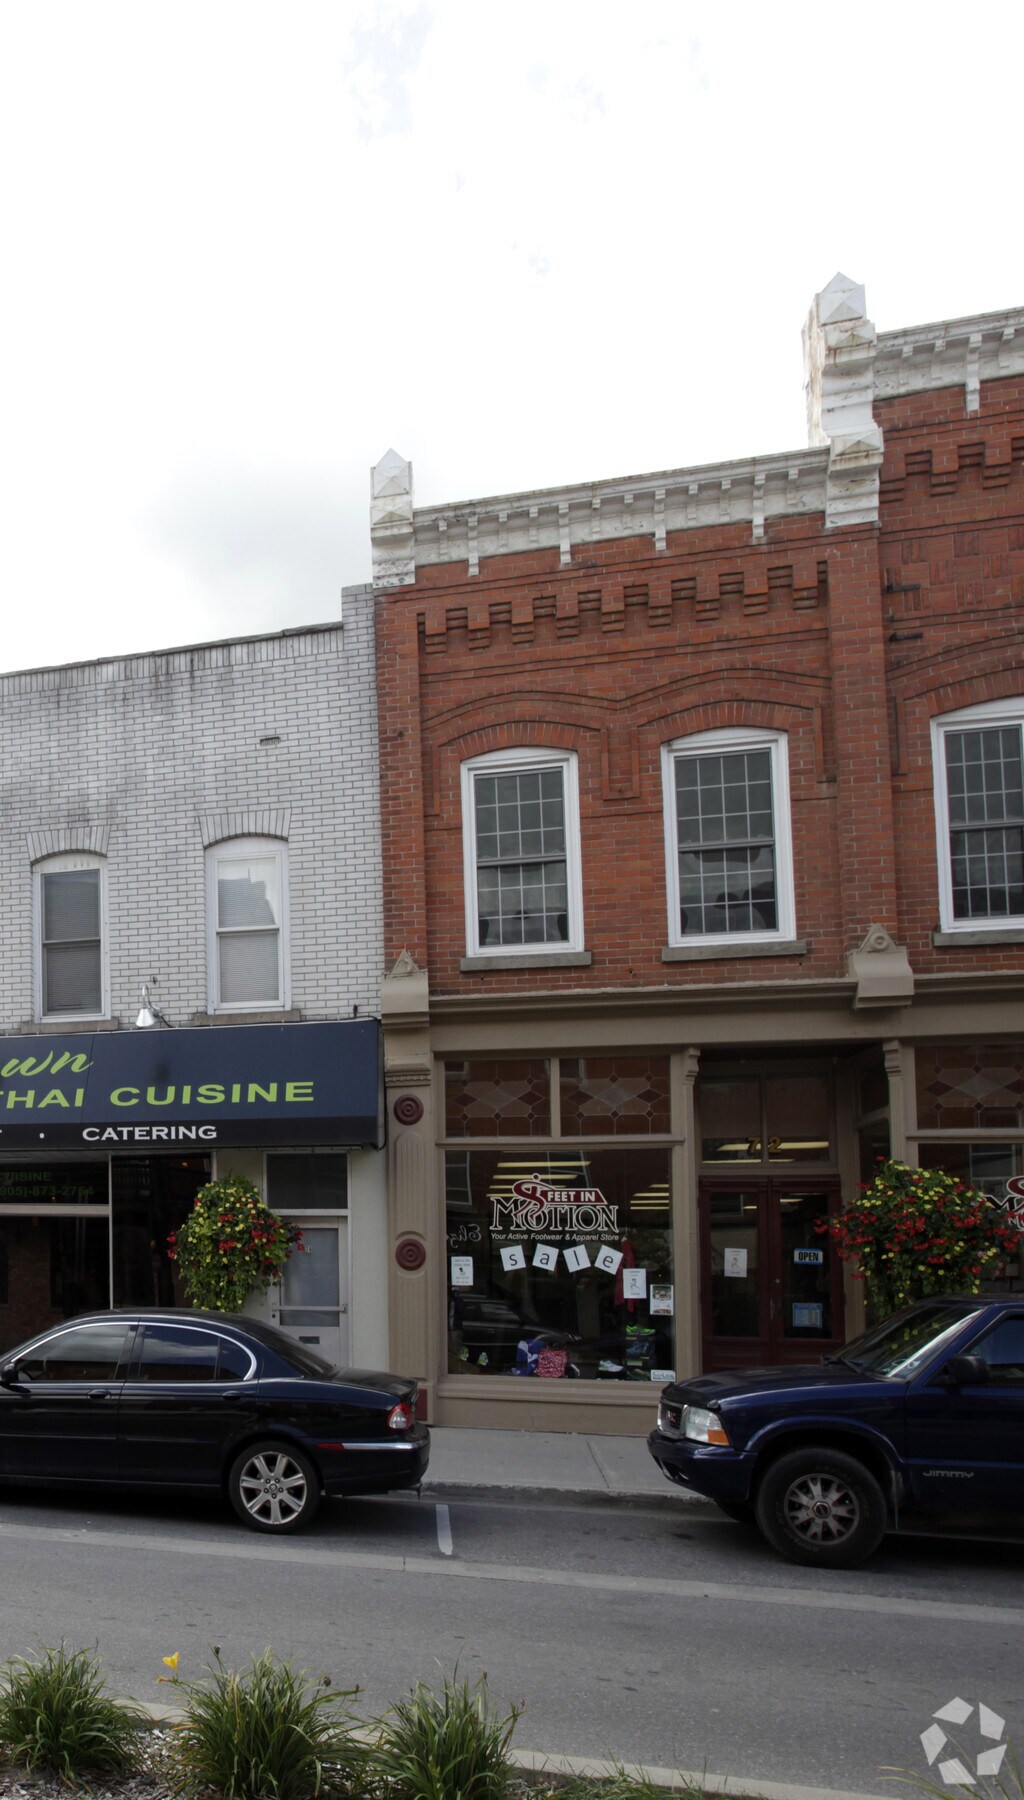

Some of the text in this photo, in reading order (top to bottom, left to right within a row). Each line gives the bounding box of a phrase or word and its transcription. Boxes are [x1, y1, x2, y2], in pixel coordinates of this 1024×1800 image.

[109, 1081, 315, 1107] CUISINE
[81, 1125, 218, 1142] CATERING
[747, 1136, 782, 1154] 72
[547, 1191, 595, 1202] FEET IN
[489, 1197, 619, 1233] MOTION
[507, 1232, 528, 1240] Active
[571, 1233, 599, 1242] Apparel
[798, 1251, 819, 1262] OPEN
